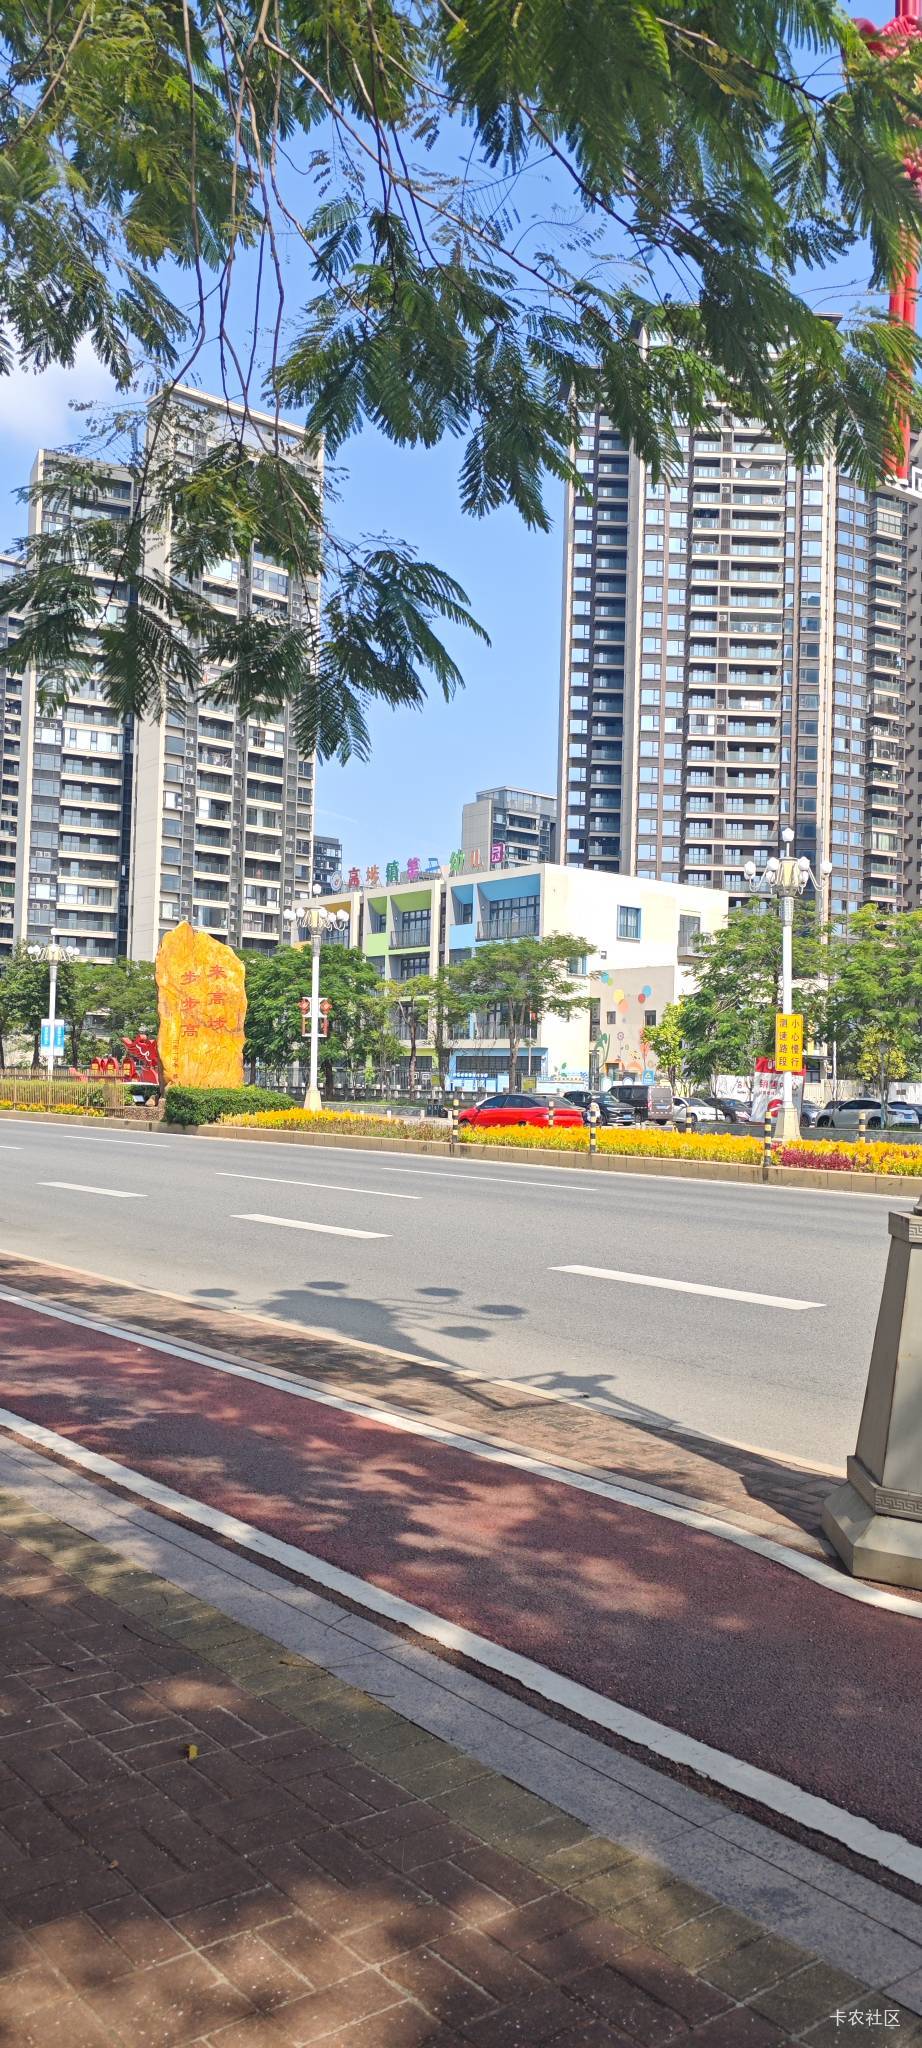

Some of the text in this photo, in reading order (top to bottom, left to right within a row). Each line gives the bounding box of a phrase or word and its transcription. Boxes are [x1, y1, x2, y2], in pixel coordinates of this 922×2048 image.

[348, 841, 506, 887] 高埗镇第二幼儿园
[180, 970, 200, 1037] 步步高
[207, 964, 228, 1032] 来高埗
[779, 1018, 788, 1066] 测速路段
[791, 1018, 800, 1067] 小心慢行
